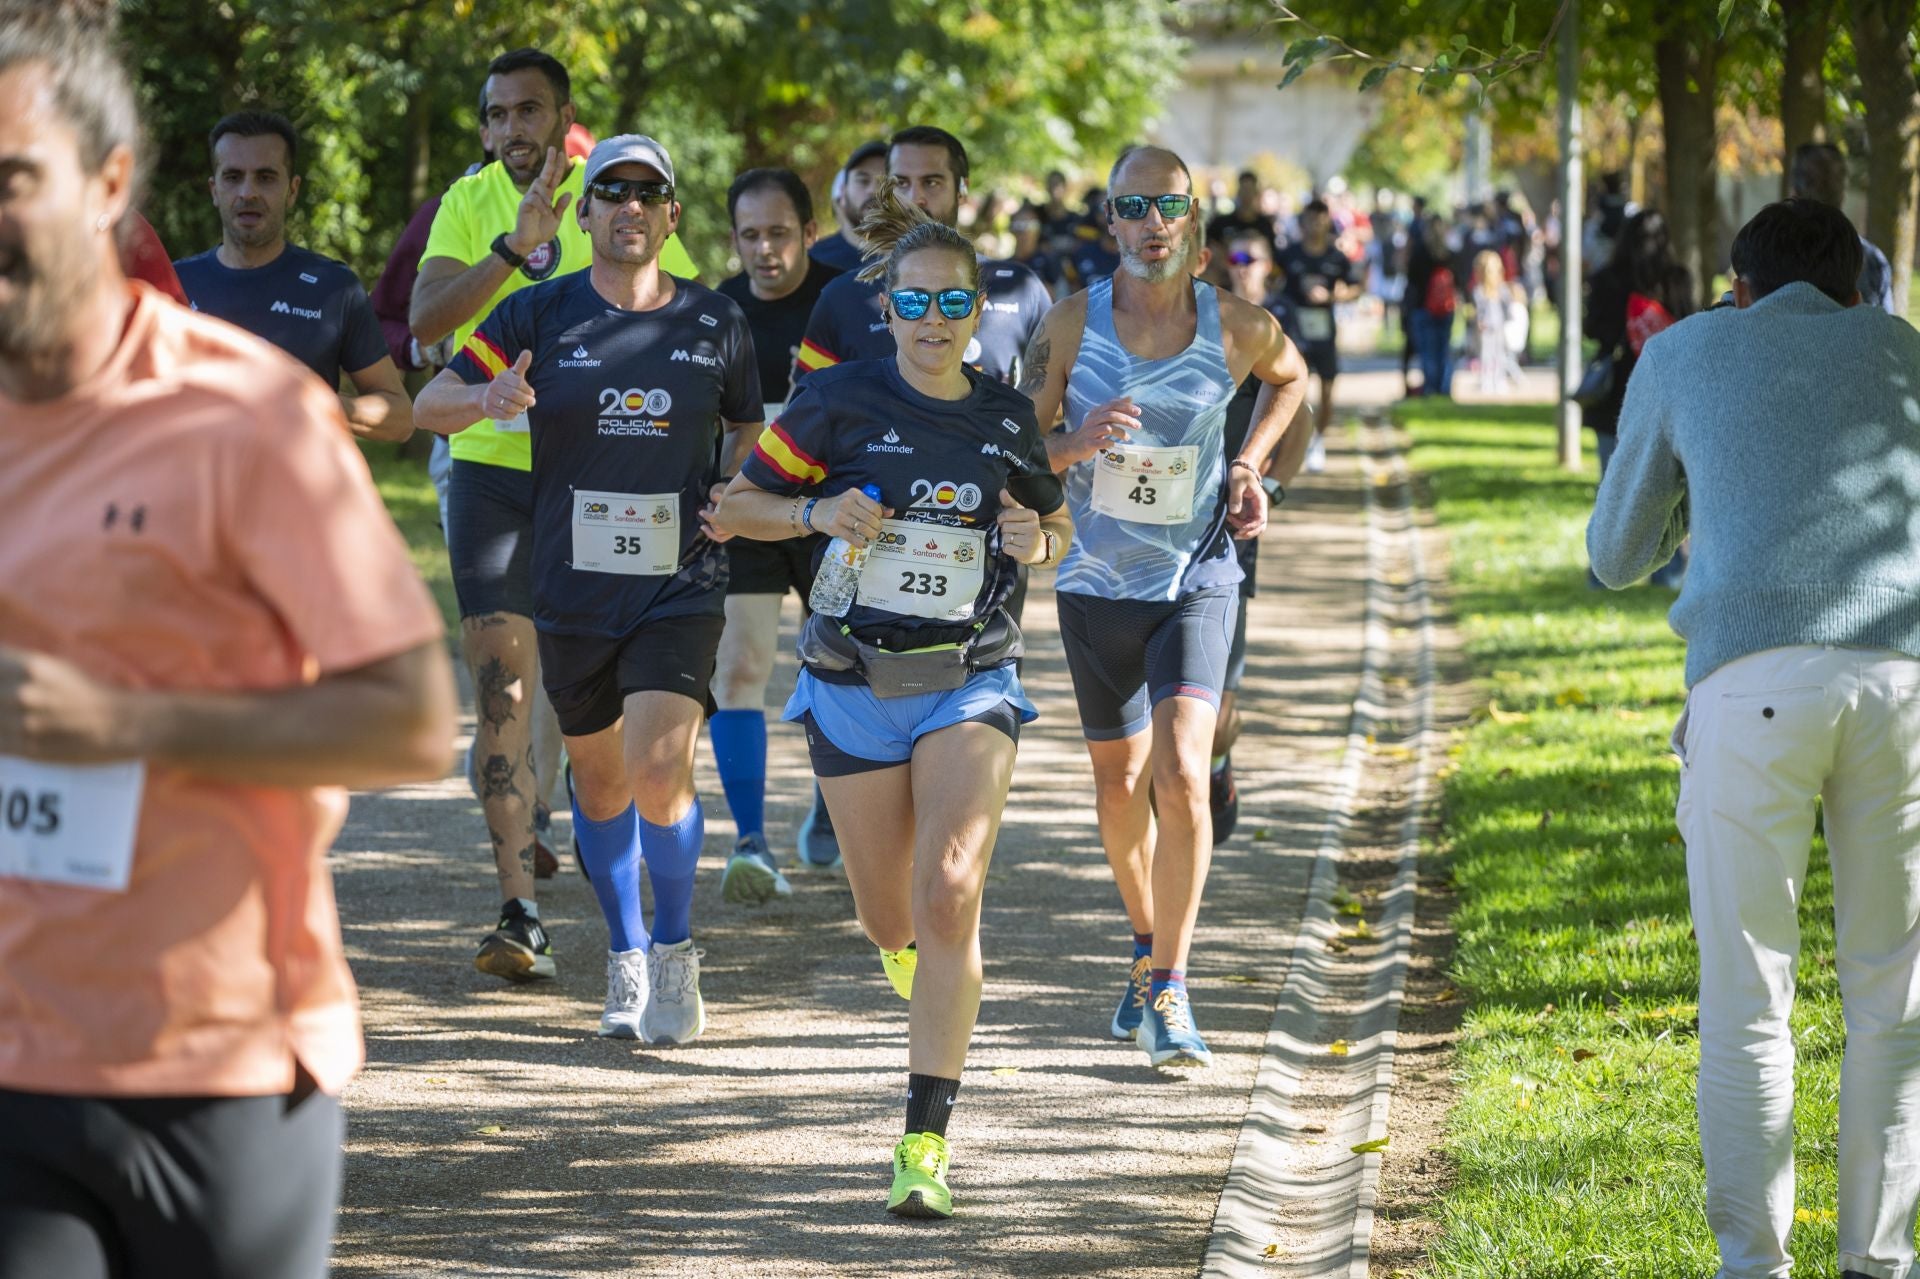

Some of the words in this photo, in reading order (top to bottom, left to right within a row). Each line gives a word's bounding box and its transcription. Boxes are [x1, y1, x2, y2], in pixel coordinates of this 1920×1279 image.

[292, 307, 322, 319] mupol
[558, 359, 601, 368] Santander
[692, 354, 716, 366] mupol
[598, 387, 672, 416] 200
[598, 419, 655, 428] POLICIA
[598, 427, 669, 436] NACIONAL
[866, 443, 914, 455] Santander
[909, 479, 982, 512] 200
[1128, 486, 1157, 505] 43
[614, 516, 646, 524] Santander
[613, 535, 641, 555] 35
[912, 549, 948, 560] Santander
[899, 571, 948, 597] 233
[0, 787, 61, 836] 05
